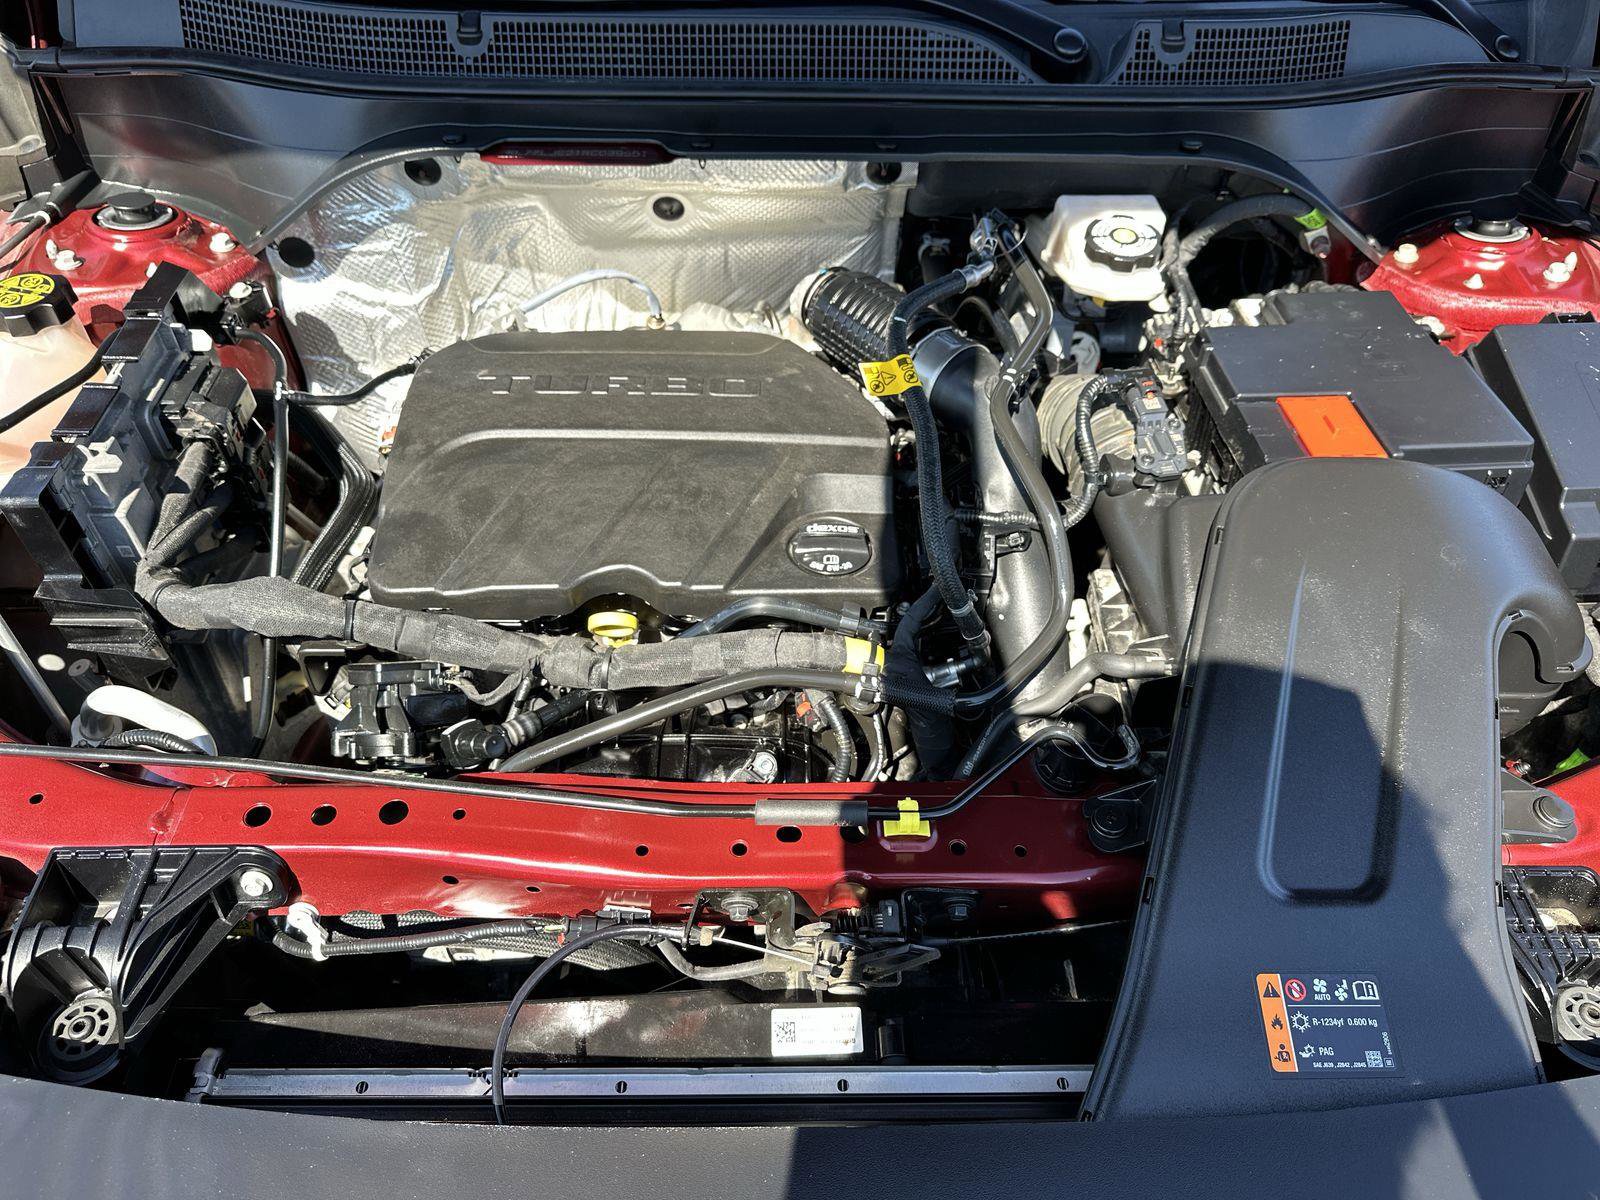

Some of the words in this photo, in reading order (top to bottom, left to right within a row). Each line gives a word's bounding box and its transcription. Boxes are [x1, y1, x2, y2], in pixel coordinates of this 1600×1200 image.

[477, 374, 762, 397] TURBO
[1314, 993, 1331, 1001] AUTO
[1312, 1017, 1344, 1027] R-1234yf
[1347, 1017, 1367, 1026] 0.600
[1368, 1017, 1378, 1028] kg
[1318, 1046, 1335, 1056] PAG
